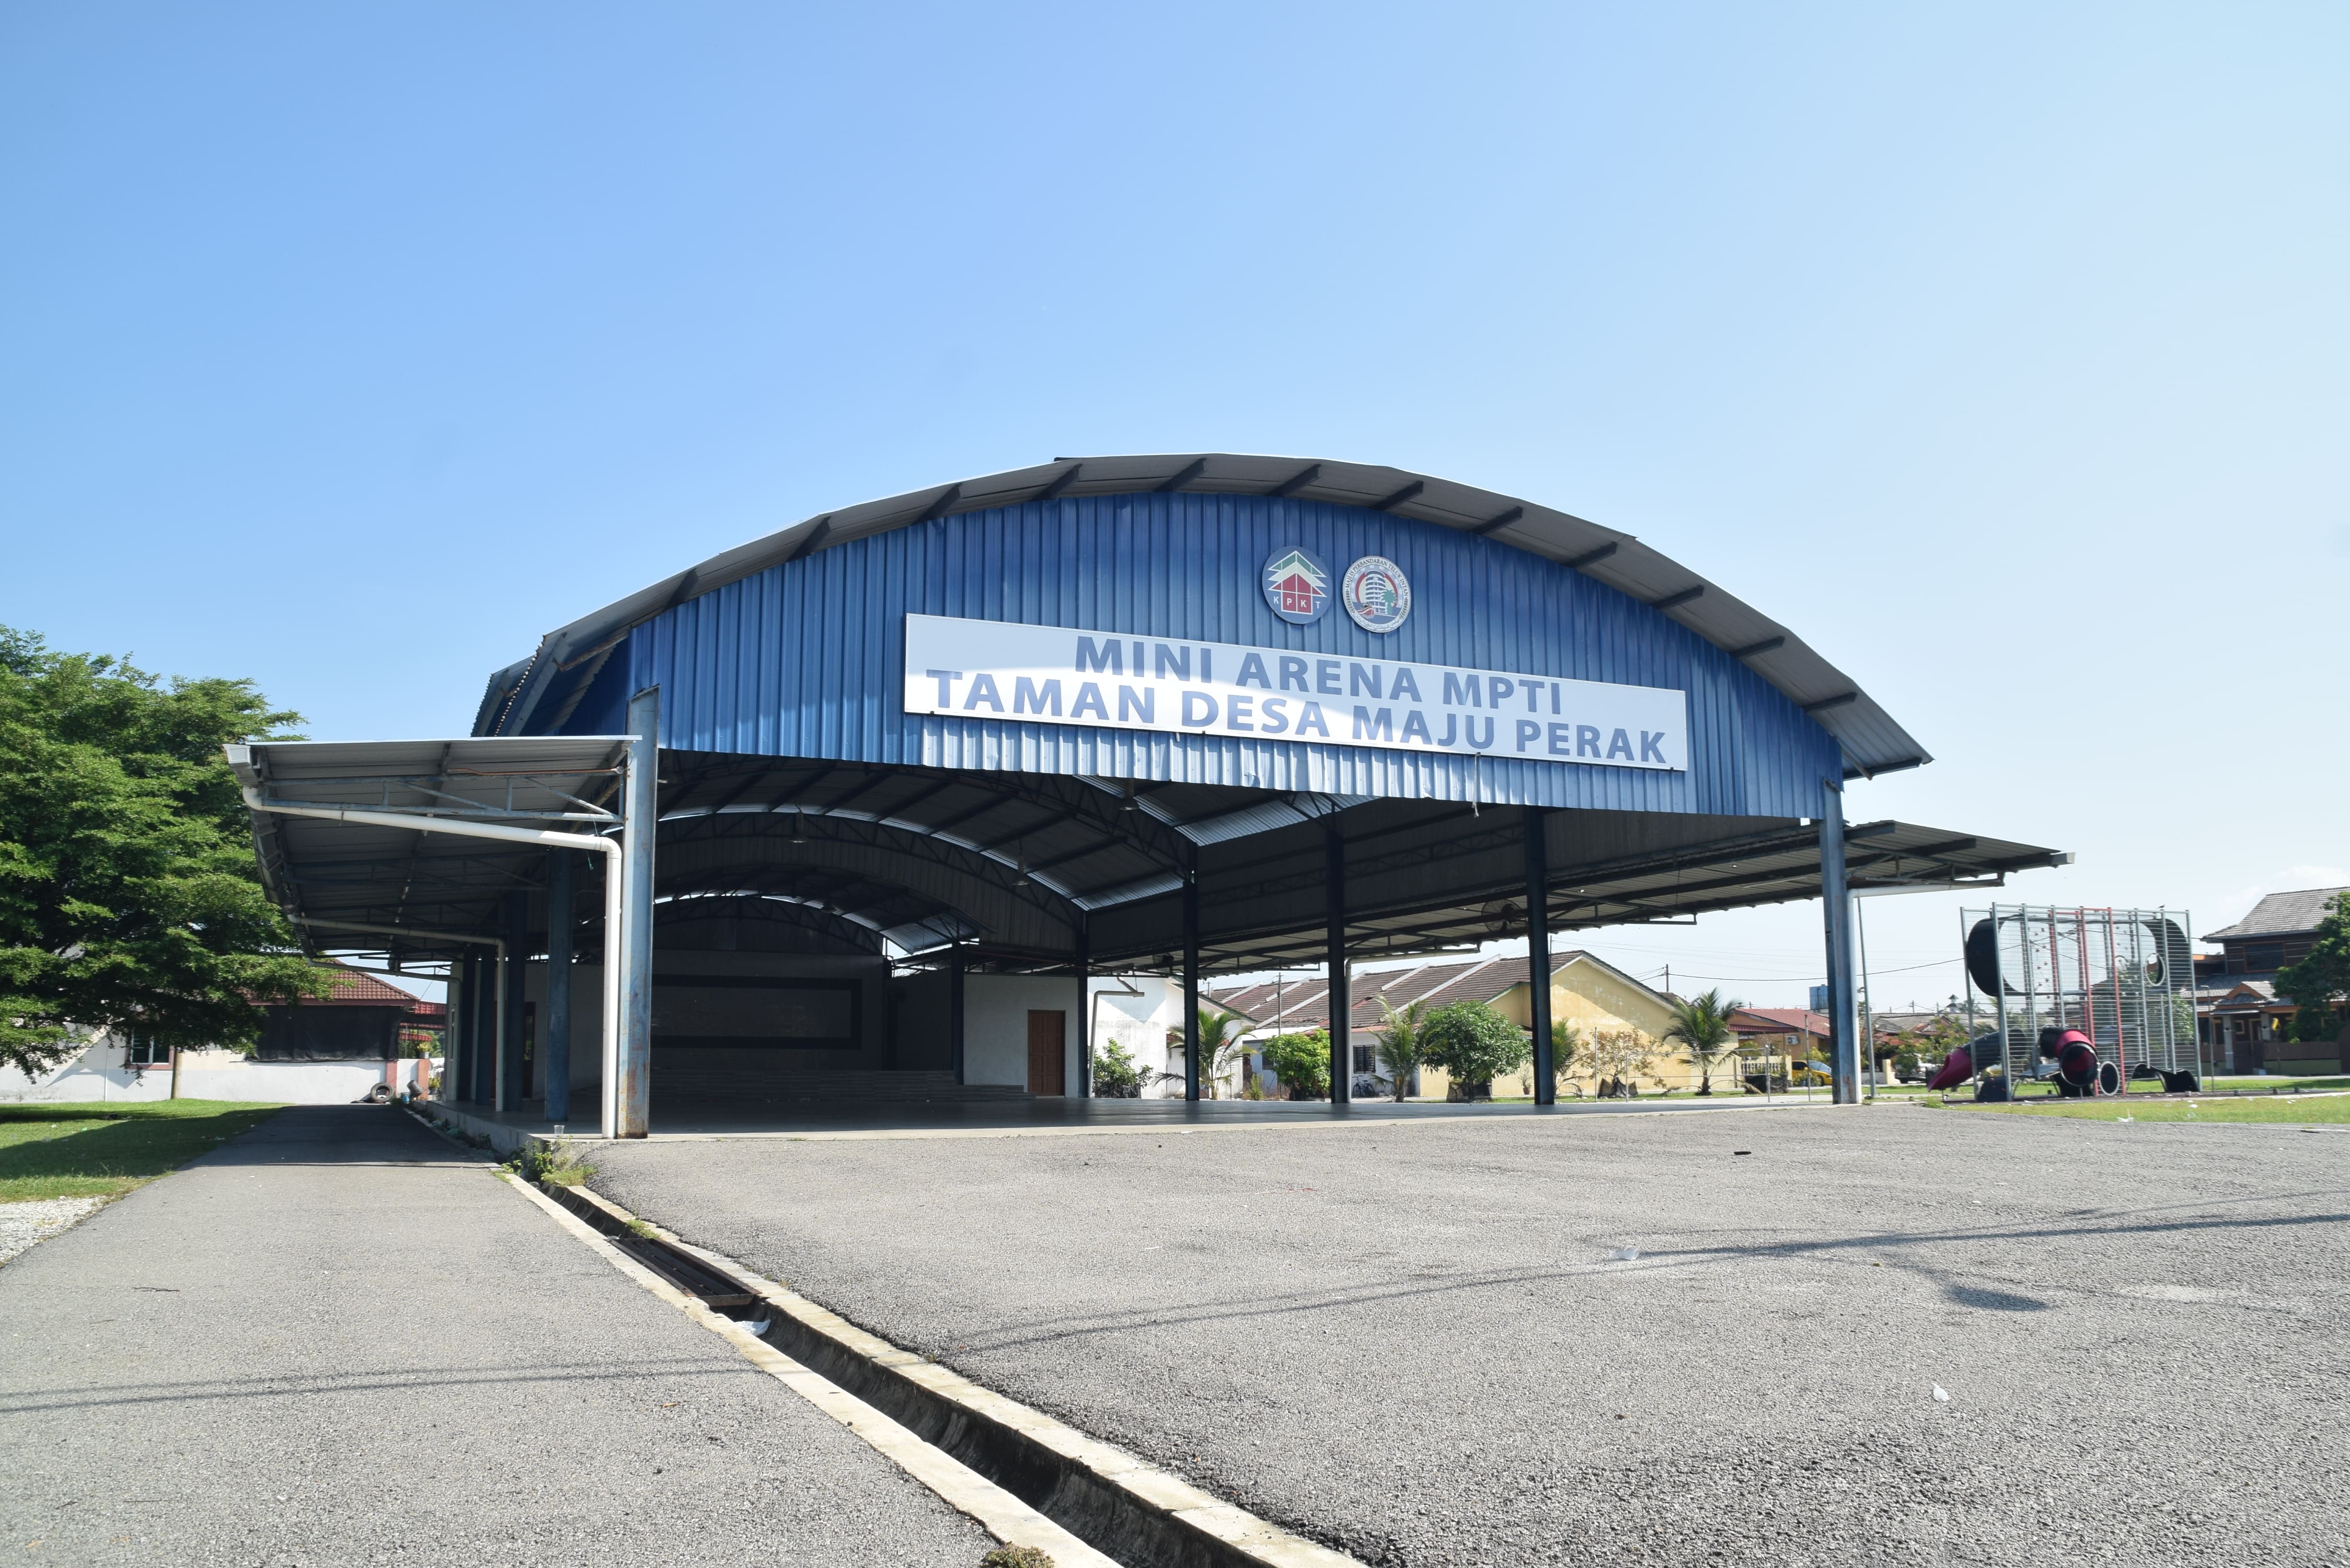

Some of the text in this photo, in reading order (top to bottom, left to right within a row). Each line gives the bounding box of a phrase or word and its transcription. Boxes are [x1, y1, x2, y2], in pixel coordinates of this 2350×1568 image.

[1273, 596, 1321, 609] KPKT
[1345, 558, 1409, 596] MAJLIS PERBANDARAN TELUK INTAN
[1075, 636, 1561, 715] MINI ARENA MPTI
[926, 669, 1667, 764] TAMAN DESA MAJU PERAK
